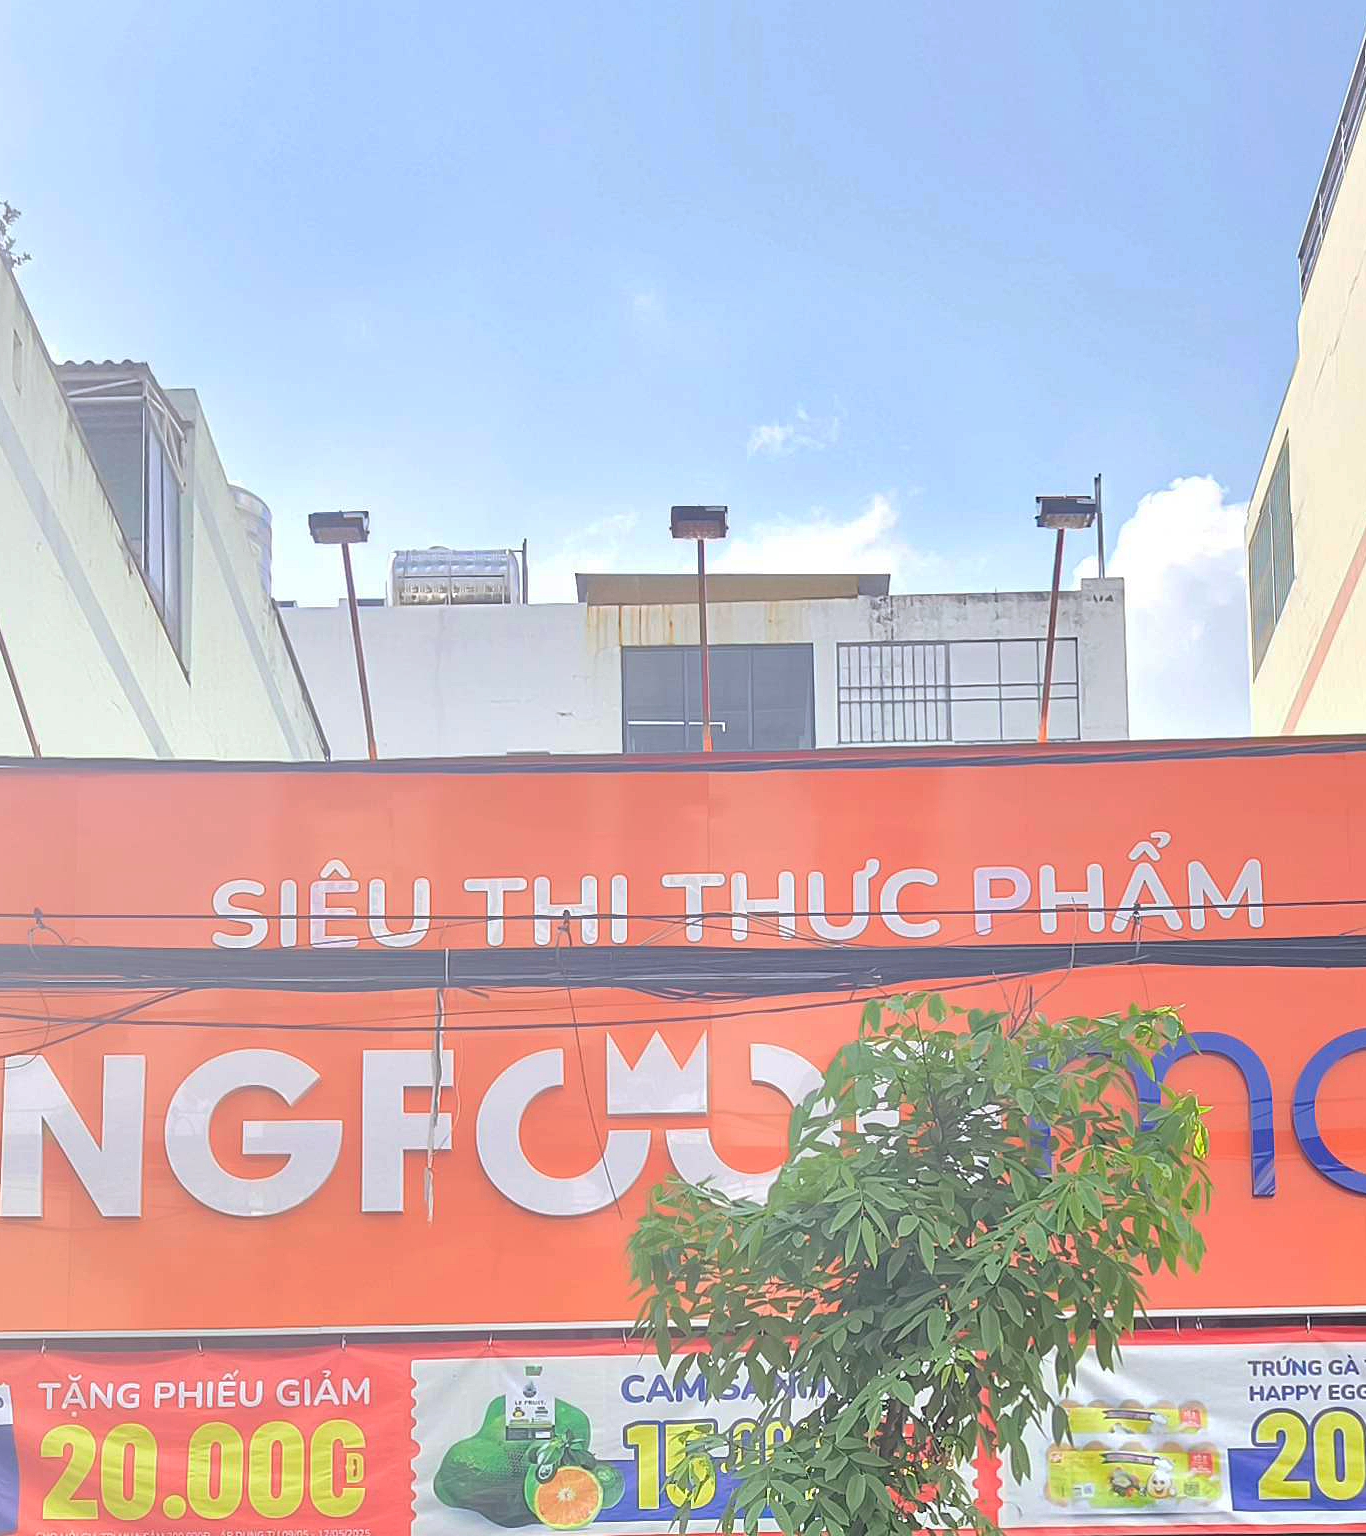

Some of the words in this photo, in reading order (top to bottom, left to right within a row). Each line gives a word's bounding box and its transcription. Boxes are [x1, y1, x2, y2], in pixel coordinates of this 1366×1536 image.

[212, 858, 432, 950] SIÊU
[973, 831, 1265, 933] PHẨM
[1248, 1356, 1322, 1376] TRỨNG
[1328, 1355, 1360, 1375] GÀ
[38, 1374, 141, 1418] TẶNG
[154, 1370, 266, 1409] PHIẾU
[276, 1372, 372, 1407] GIẢM
[621, 1374, 706, 1402] CAM
[1249, 1385, 1321, 1401] HAPPY
[623, 1418, 829, 1511] 15.00
